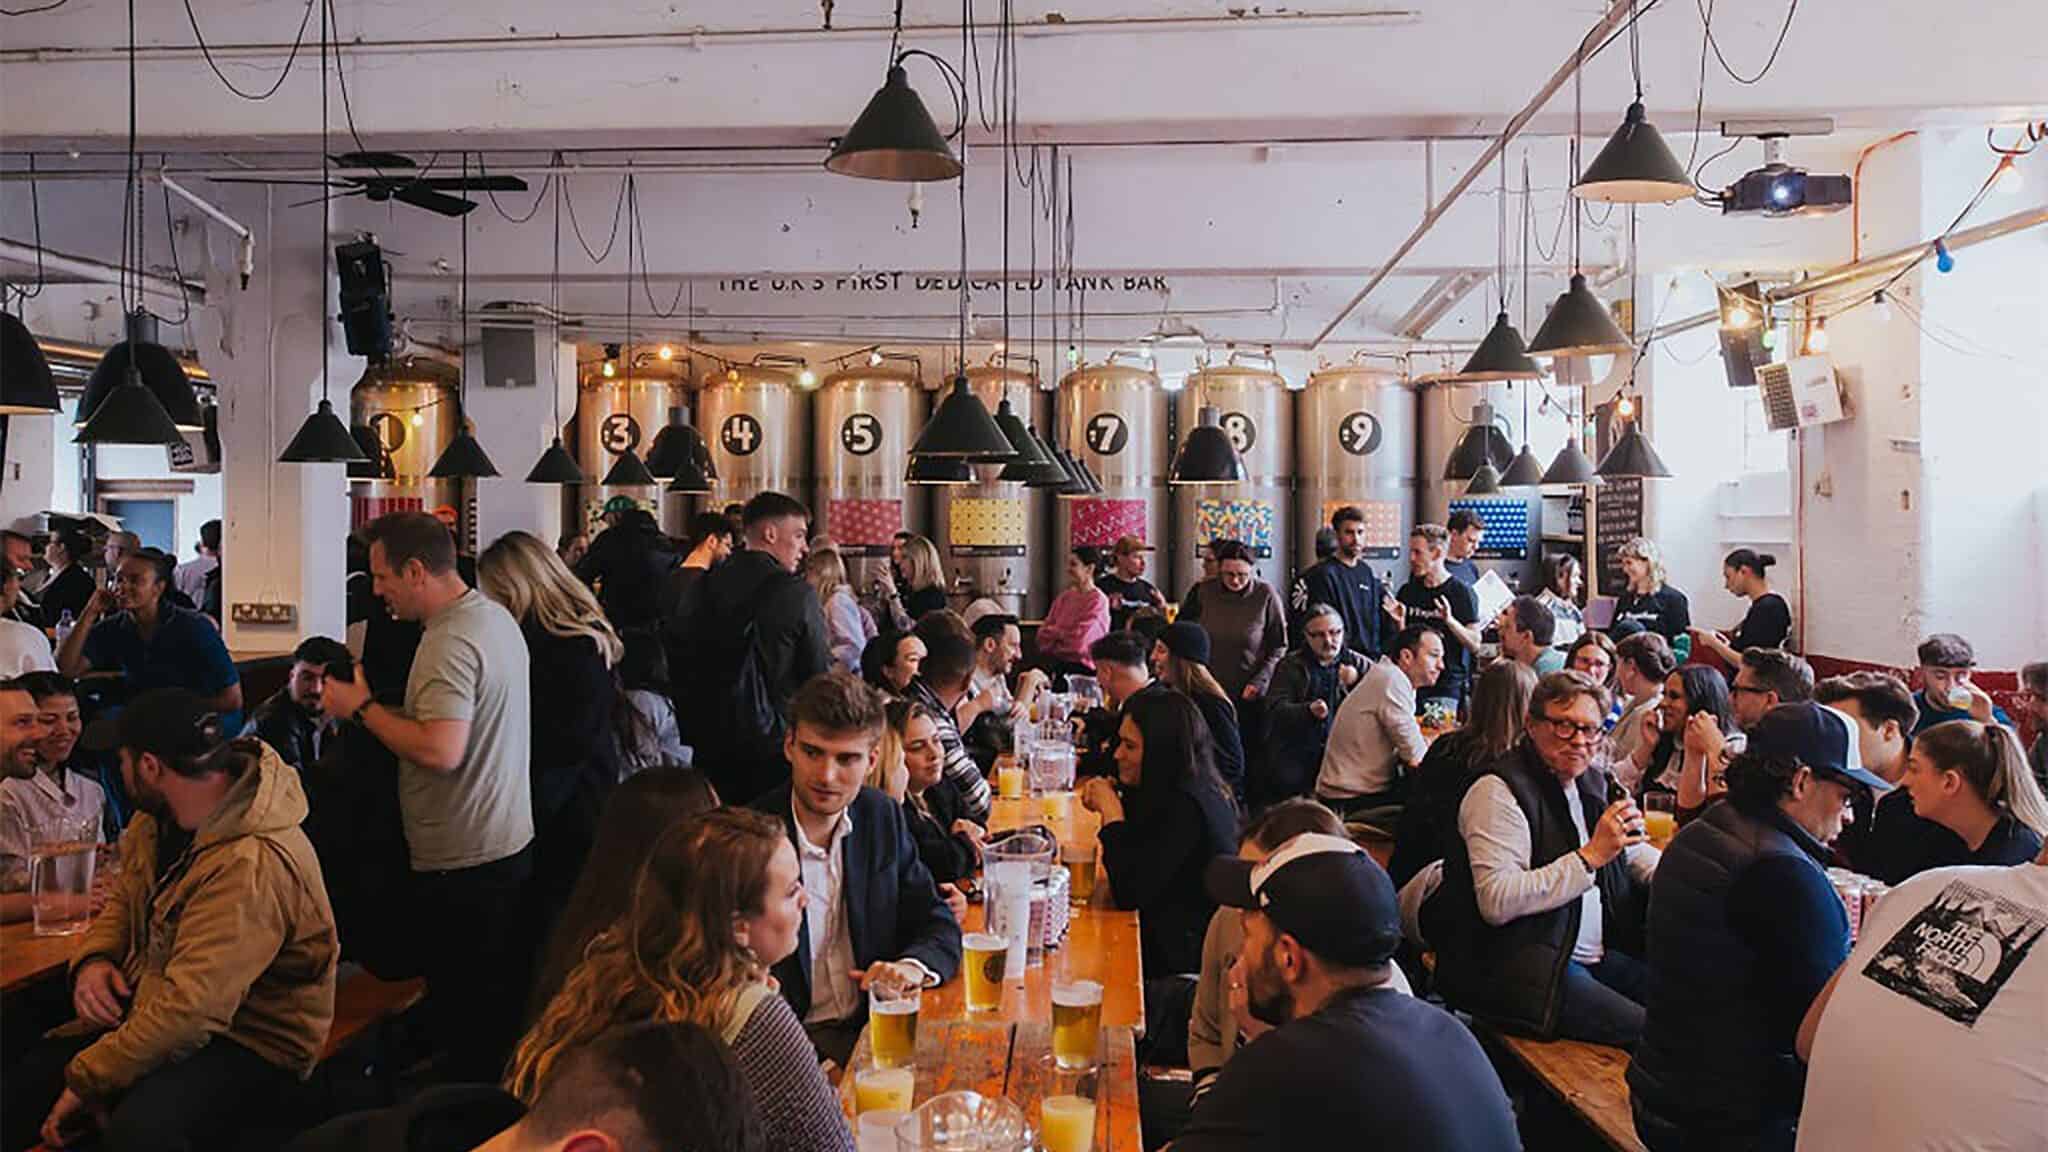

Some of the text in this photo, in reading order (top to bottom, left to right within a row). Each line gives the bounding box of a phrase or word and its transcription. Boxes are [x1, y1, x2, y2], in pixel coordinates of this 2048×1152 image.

[836, 271, 904, 291] FIRST
[915, 276, 1044, 291] DEDCAED
[1123, 275, 1168, 291] BAR
